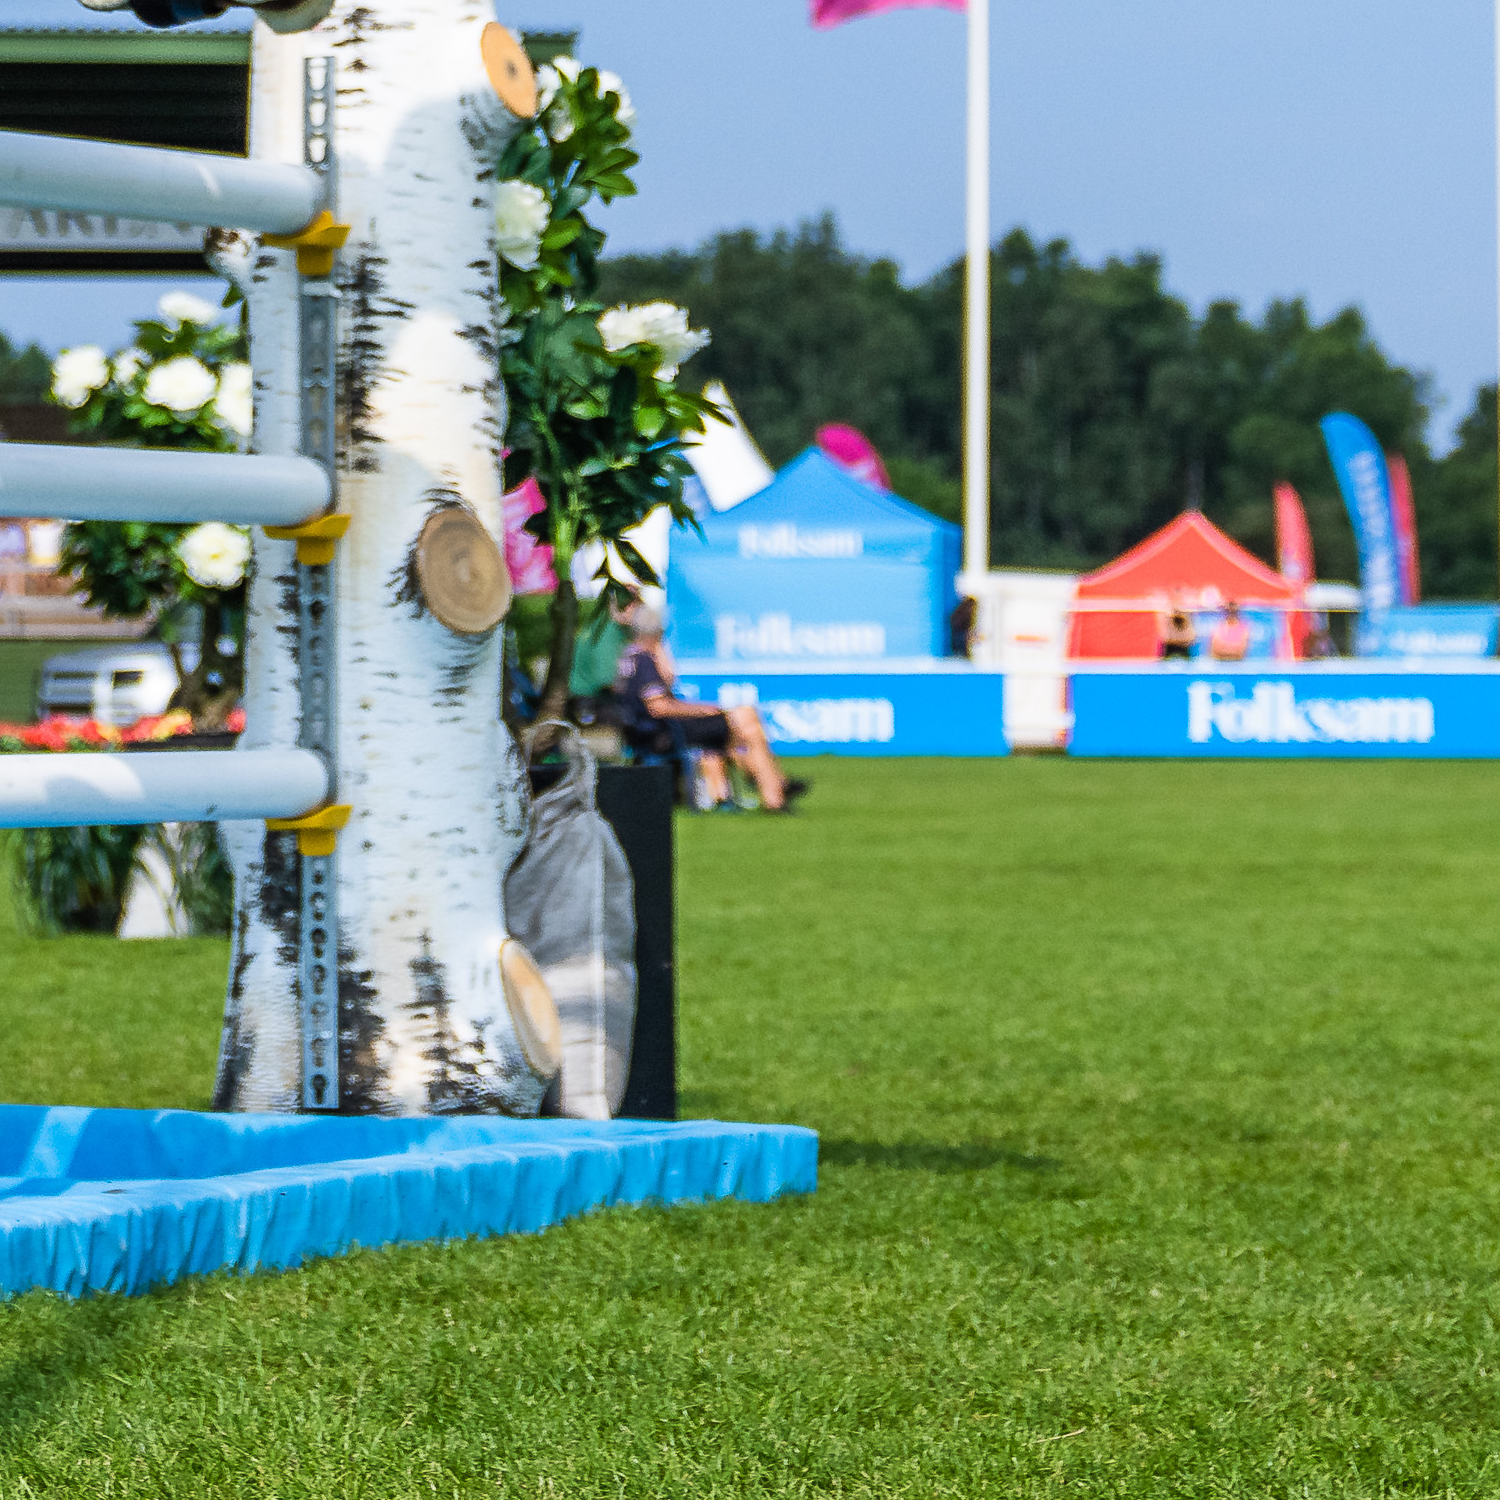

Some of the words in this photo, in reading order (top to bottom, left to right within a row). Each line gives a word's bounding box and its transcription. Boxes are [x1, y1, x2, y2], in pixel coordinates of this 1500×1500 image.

[738, 524, 864, 558] Folksam
[717, 615, 885, 657] Folksam
[1187, 681, 1435, 743] Folksam
